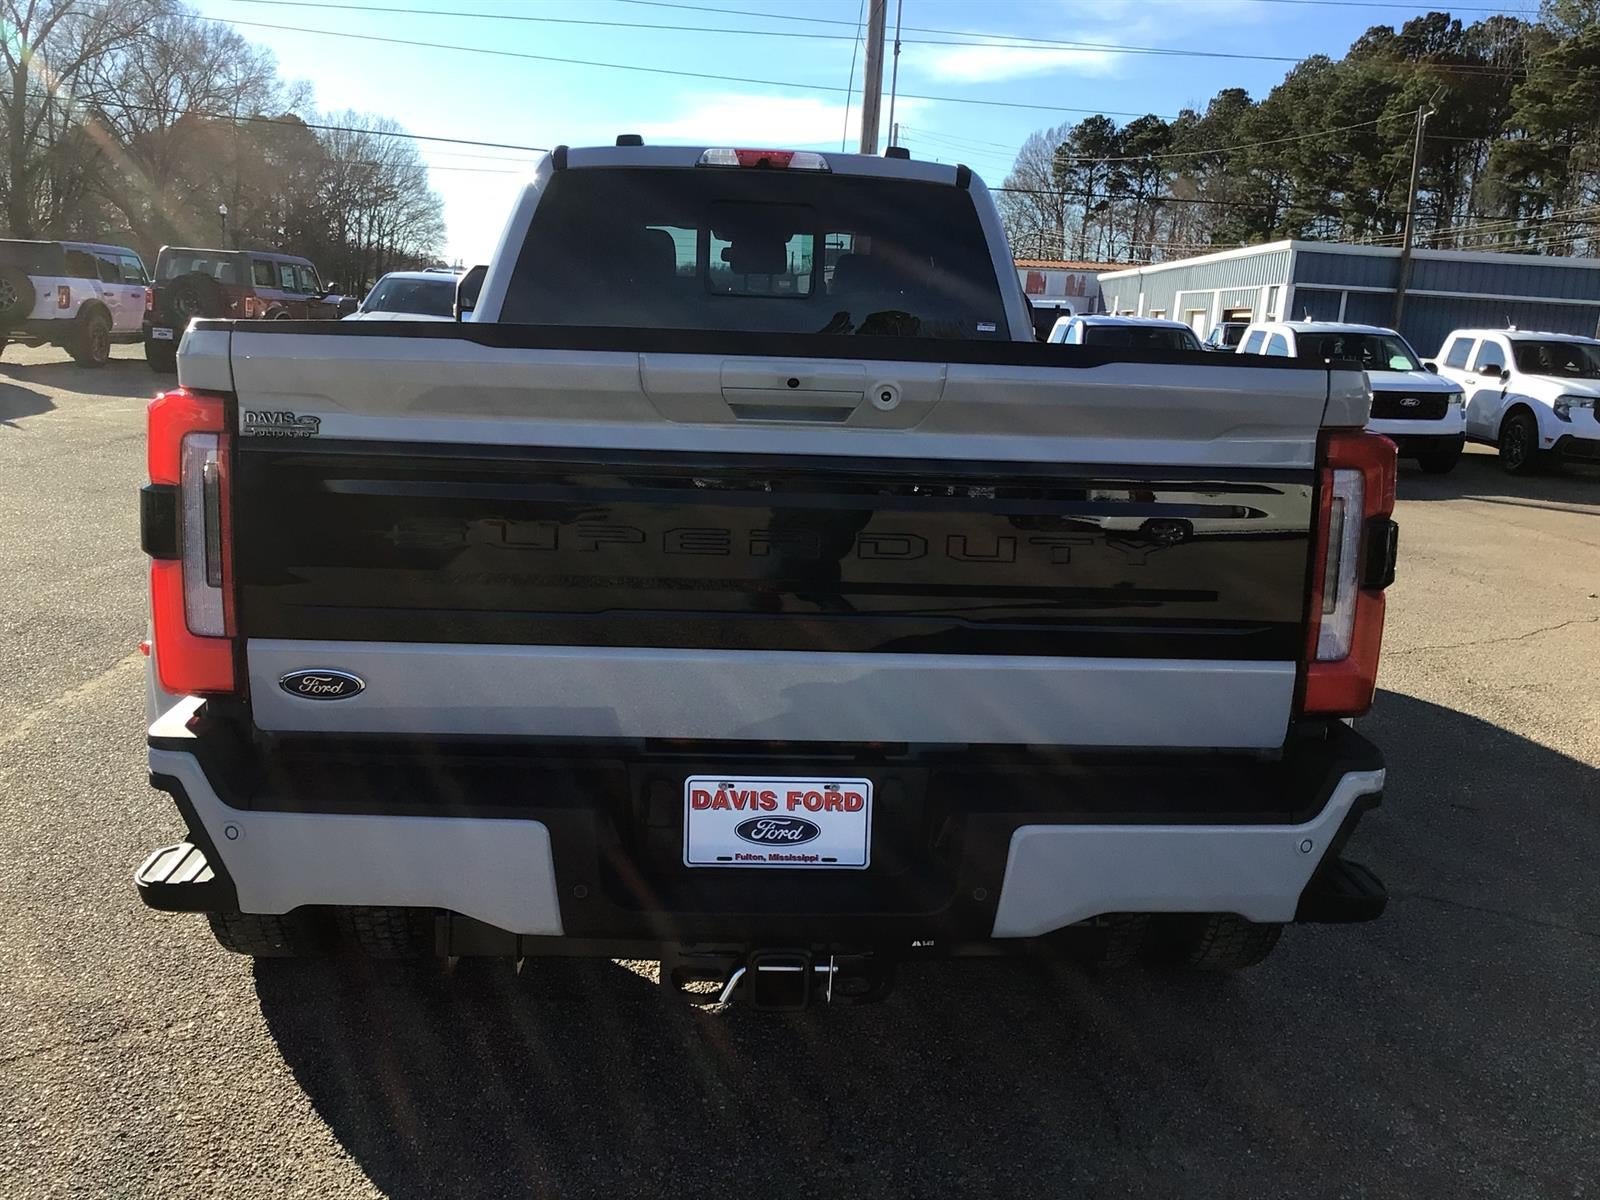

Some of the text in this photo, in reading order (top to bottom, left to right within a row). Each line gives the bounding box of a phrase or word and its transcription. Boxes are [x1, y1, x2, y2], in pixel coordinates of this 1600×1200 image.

[244, 411, 295, 424] DAVIS
[857, 532, 1173, 566] DUTY
[299, 676, 344, 694] Ford
[691, 789, 864, 812] DAVIS FORD
[751, 819, 804, 841] Ford
[735, 853, 819, 863] Fulton, Mississippi
